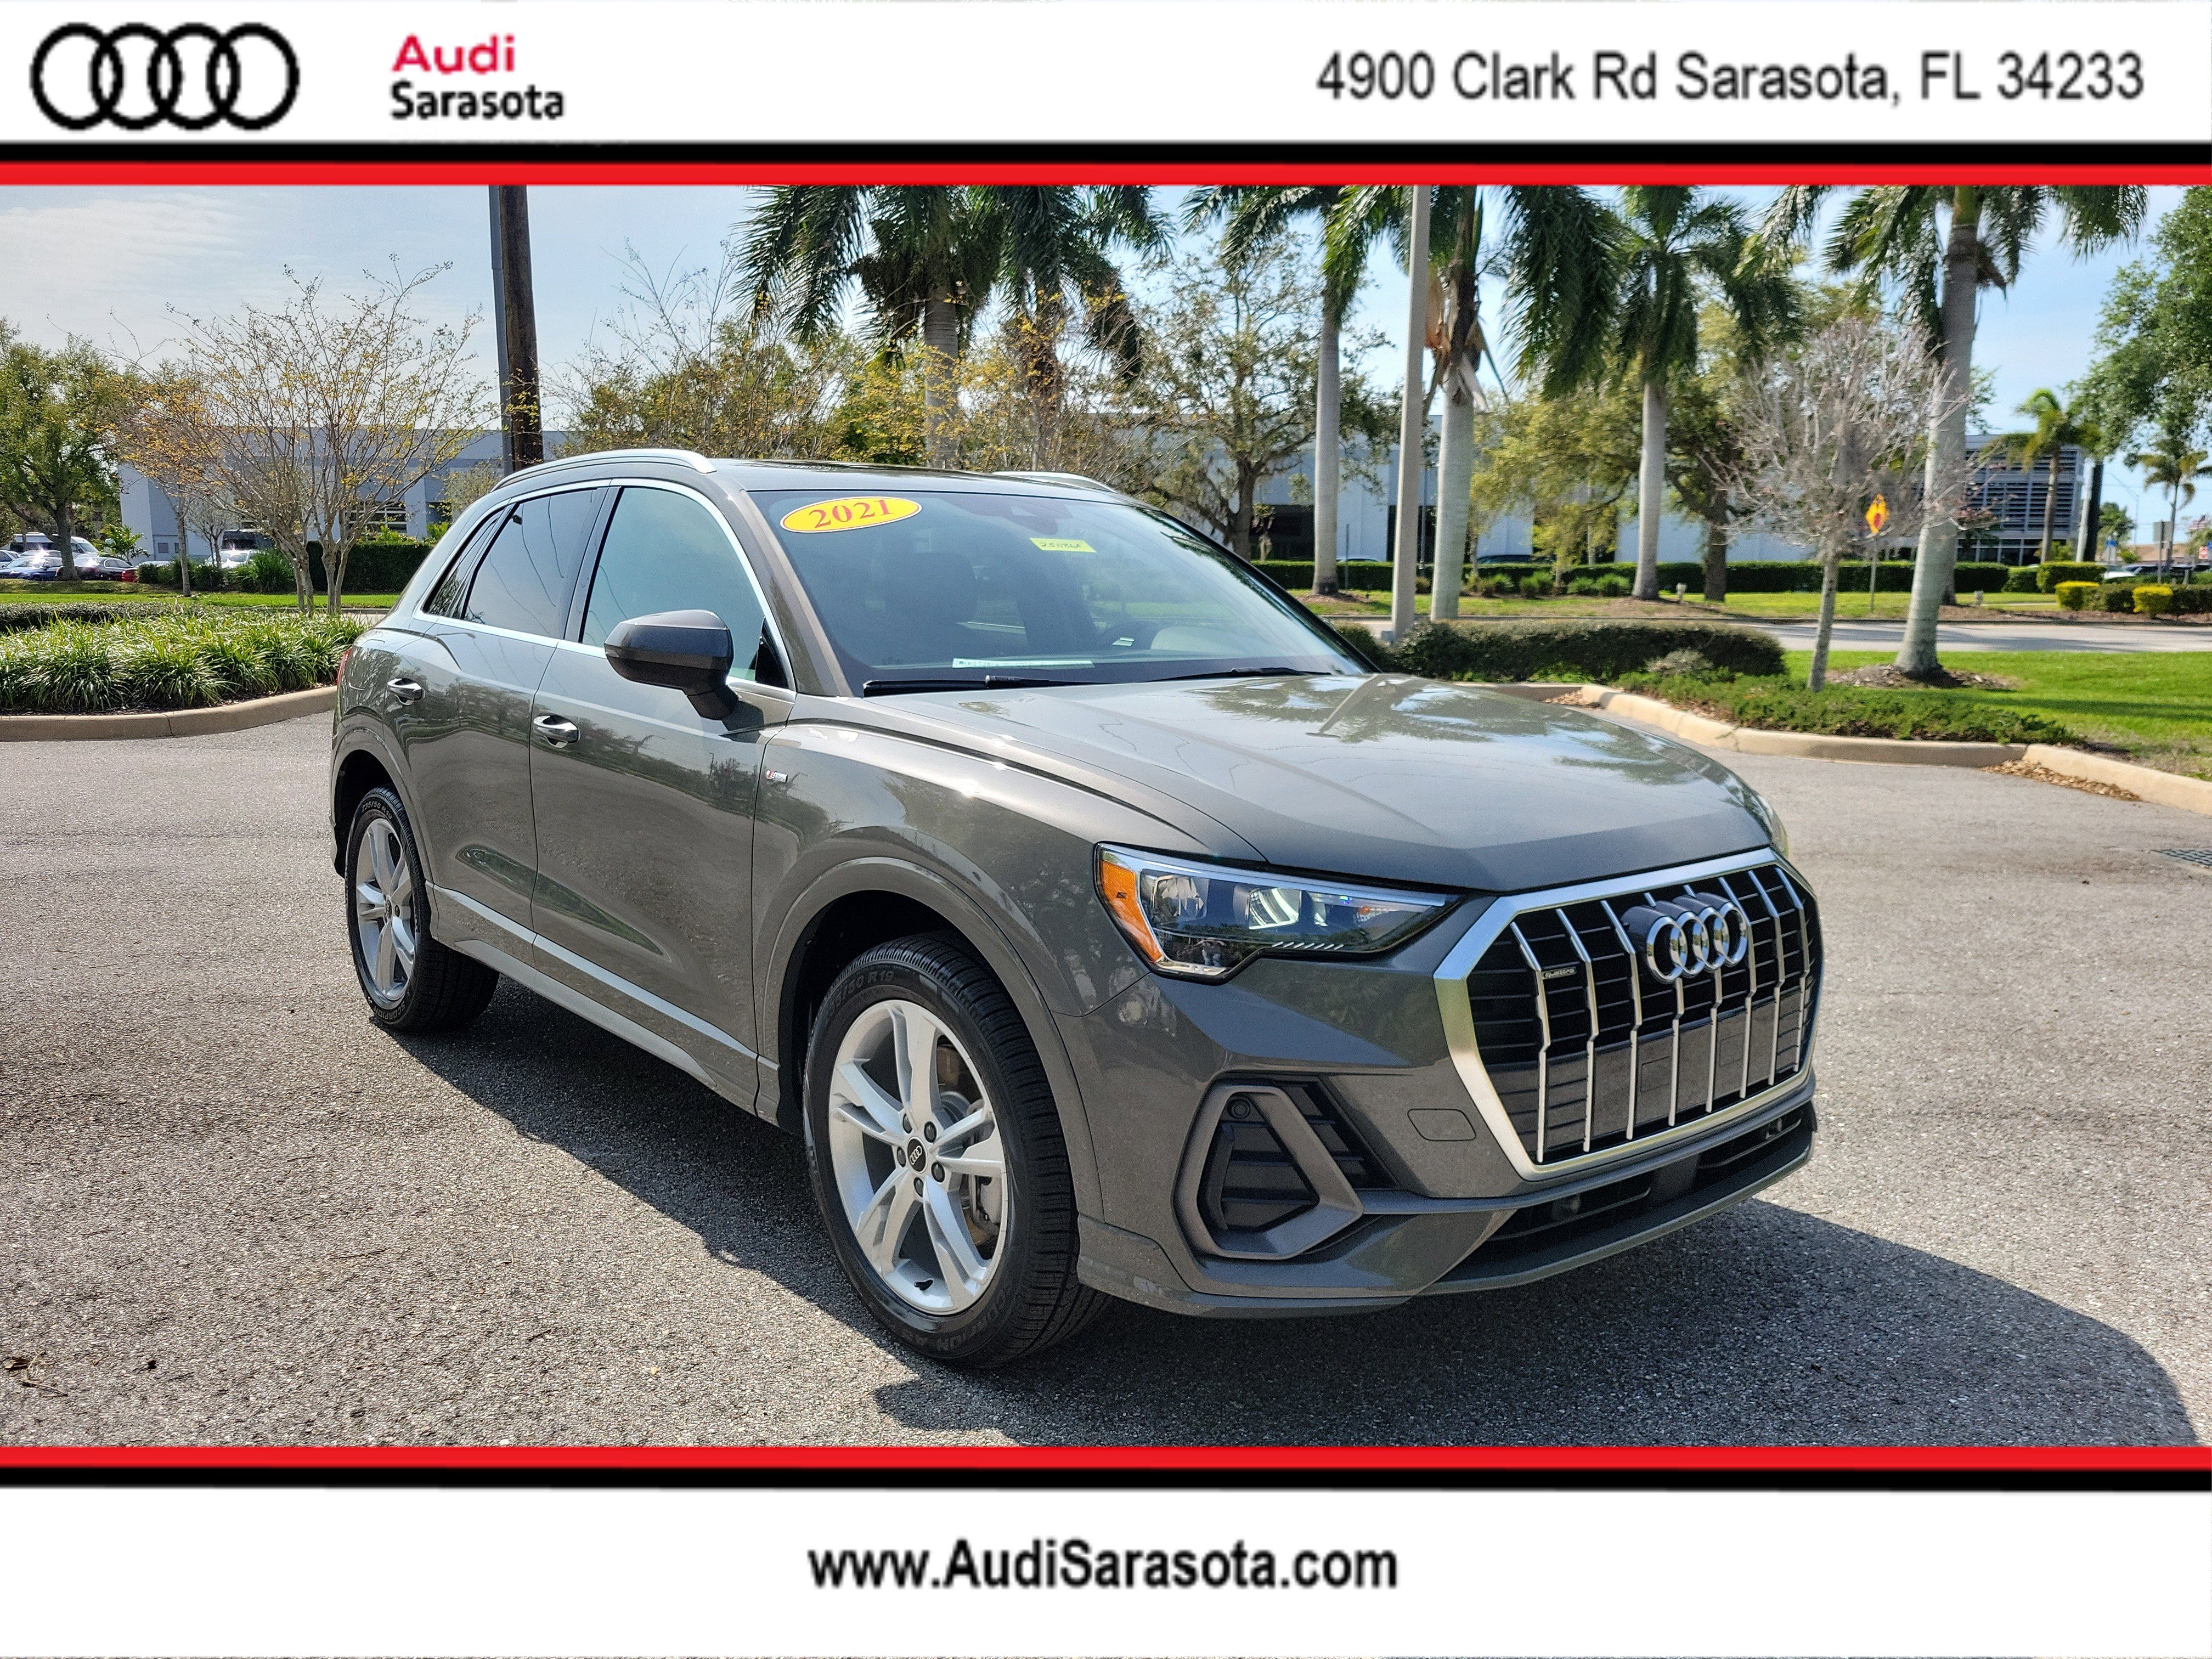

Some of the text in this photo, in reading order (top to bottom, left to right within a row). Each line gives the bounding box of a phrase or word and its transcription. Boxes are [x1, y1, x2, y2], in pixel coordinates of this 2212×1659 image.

[809, 499, 893, 528] 2021
[867, 970, 894, 984] R19
[374, 1000, 406, 1020] SCORPION
